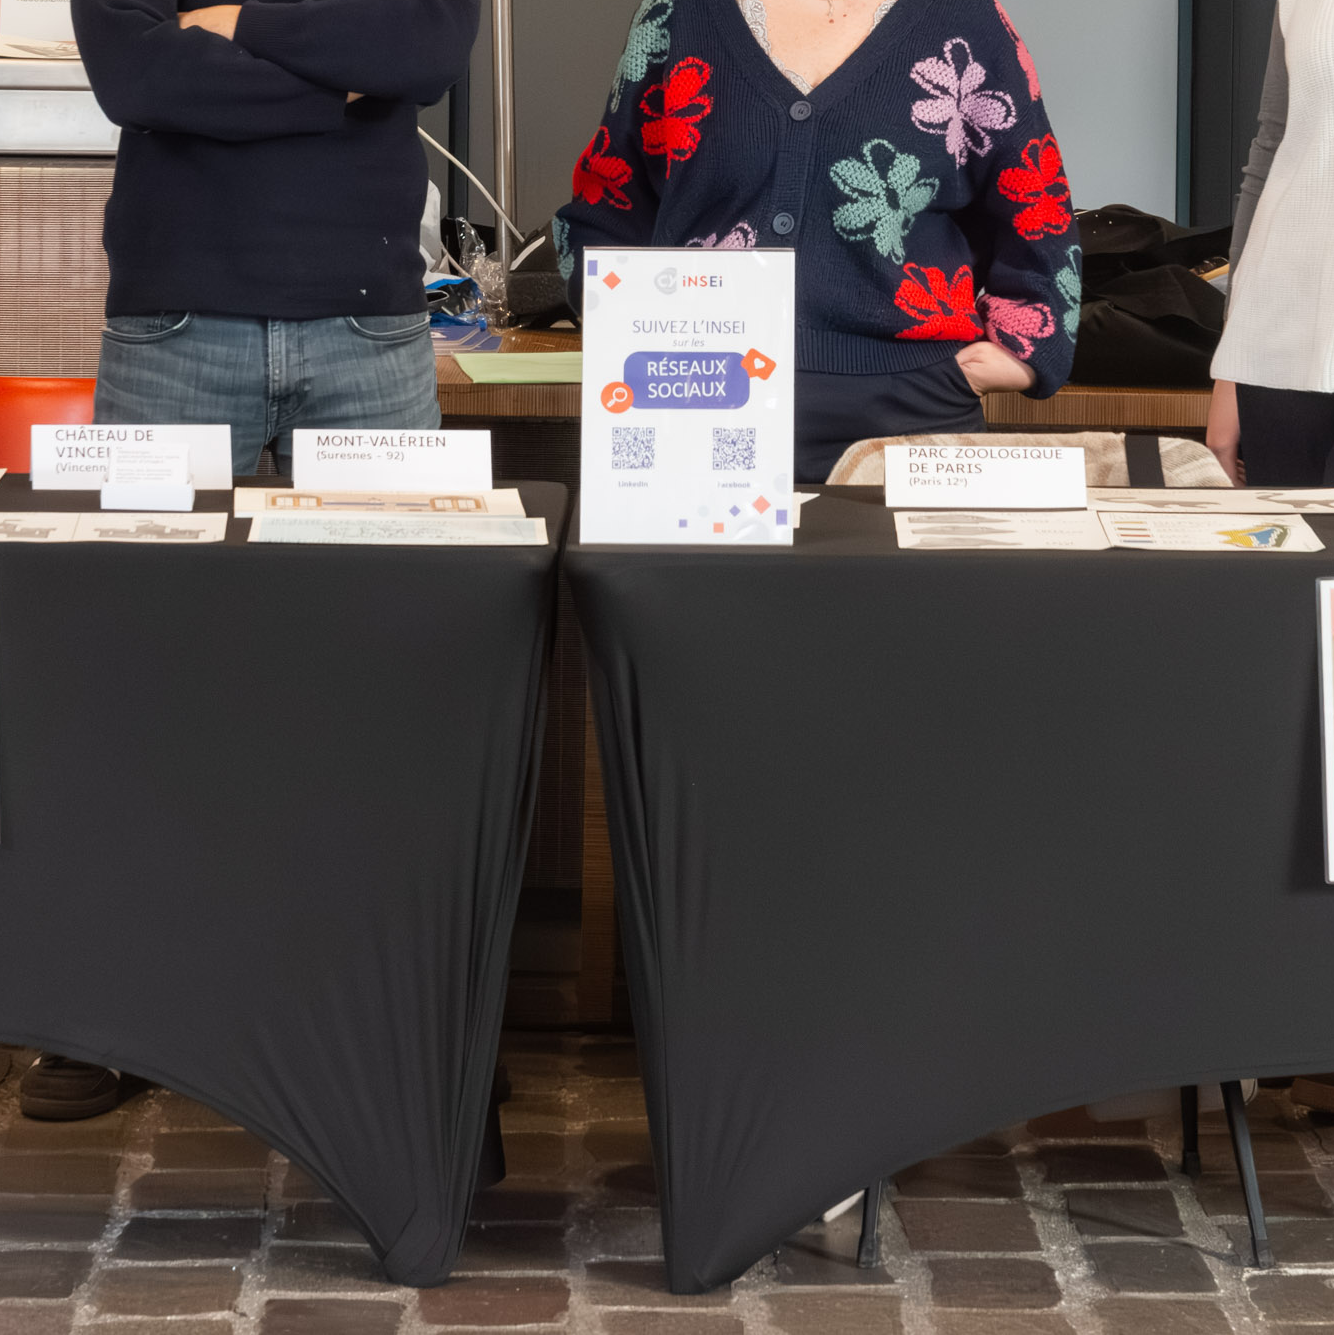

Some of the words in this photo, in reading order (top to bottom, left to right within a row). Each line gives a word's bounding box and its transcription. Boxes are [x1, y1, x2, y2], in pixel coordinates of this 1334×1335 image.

[632, 320, 687, 334] SUIVEZ
[673, 339, 688, 347] sur
[691, 338, 705, 347] les
[647, 357, 727, 376] RÉSEAUX
[648, 382, 726, 398] SOCIAUX
[55, 426, 127, 442] CHÂTEAU
[134, 430, 154, 442] DE
[317, 433, 446, 447] MONT-VALÉRIEN
[56, 446, 110, 458] VINCE
[317, 451, 372, 461] (Suresnes
[386, 451, 405, 461] 92)
[909, 448, 948, 458] PARC
[955, 448, 1063, 460] ZOOLOGIQUE
[909, 463, 928, 473] DE
[936, 463, 982, 474] PARIS
[618, 480, 648, 488] LinkedIn
[909, 477, 941, 487] (Paris
